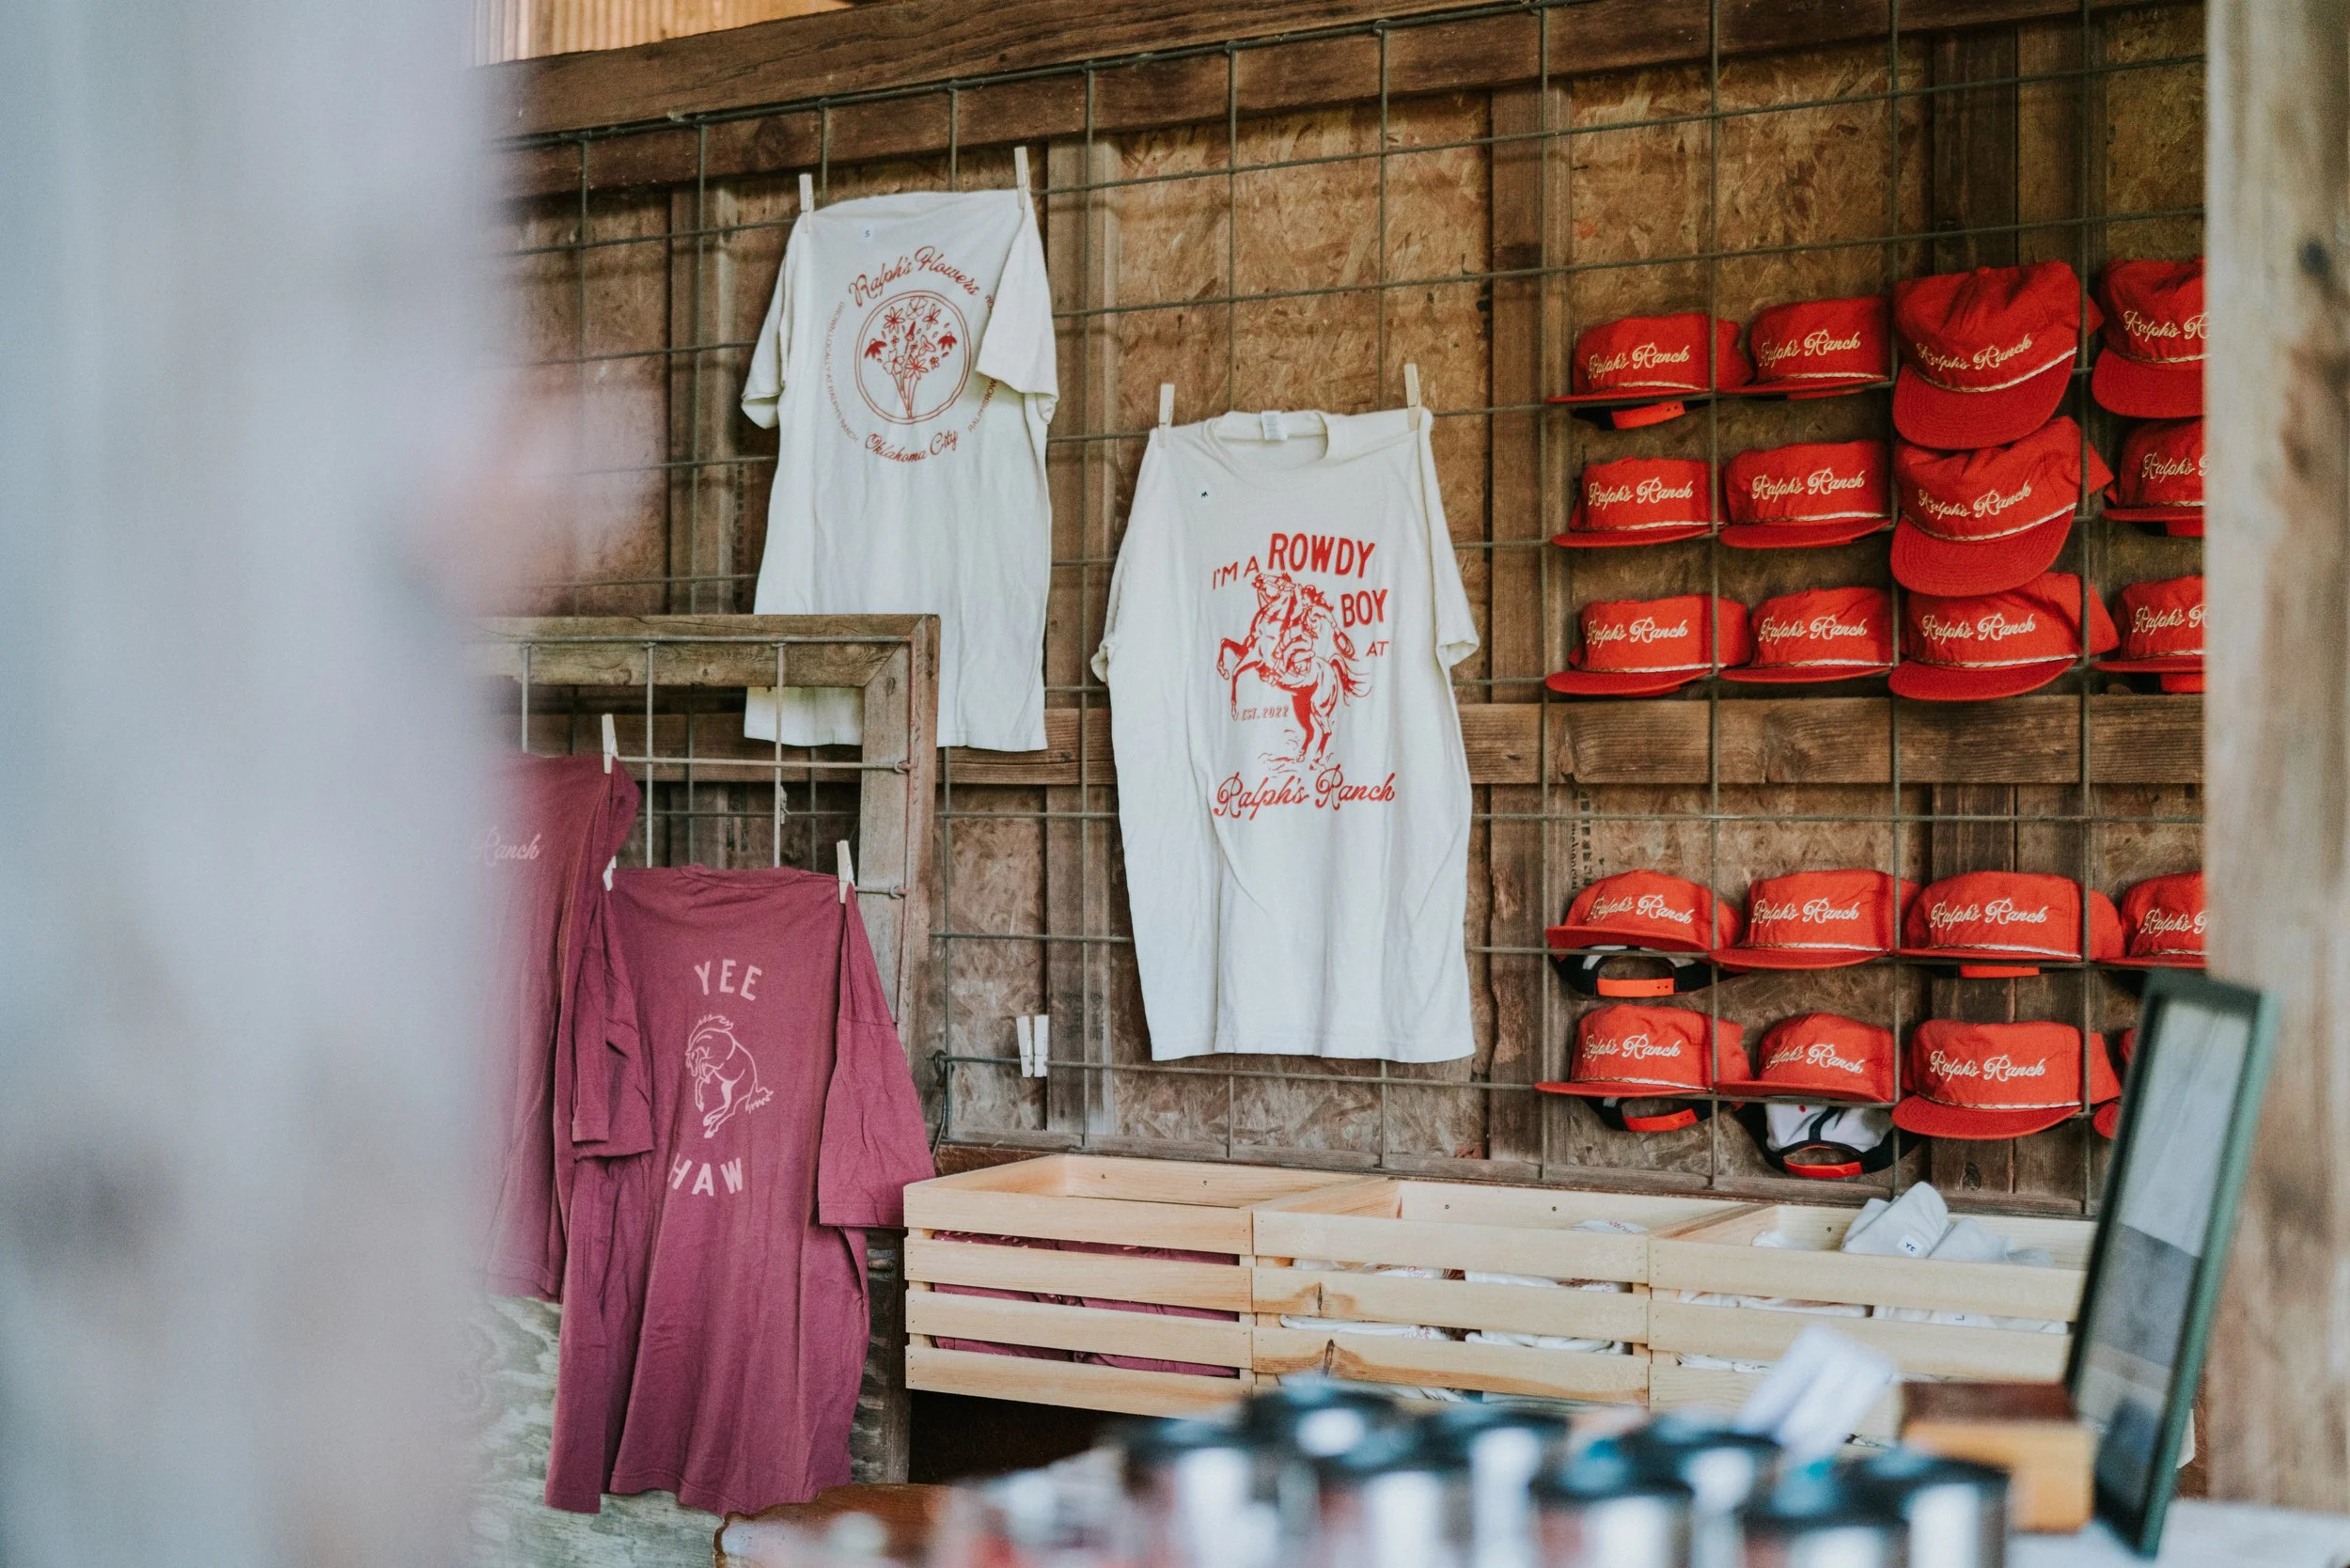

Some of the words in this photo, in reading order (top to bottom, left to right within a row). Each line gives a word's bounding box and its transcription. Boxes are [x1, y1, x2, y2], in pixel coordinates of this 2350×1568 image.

[849, 256, 913, 307] Ralph's
[915, 245, 979, 295] Flowers
[2123, 311, 2181, 342] Ralph's
[1589, 353, 1629, 381] Ralph's
[1632, 341, 1690, 369] Ranch
[1760, 340, 1800, 368] Ralph's
[1804, 329, 1860, 356] Ranch
[1917, 343, 1970, 371] Ralph's
[1973, 333, 2031, 370] Ranch
[865, 433, 928, 463] Oklahoma
[930, 430, 958, 456] City
[2142, 453, 2195, 483] Ralph's
[1589, 481, 1634, 510] Ralph's
[1637, 477, 1693, 503] Ranch
[1752, 474, 1804, 503] Ralph's
[1808, 467, 1865, 494] Ranch
[1919, 489, 1970, 520] Ralph's
[1973, 480, 2031, 518] Ranch
[1213, 561, 1238, 590] I'M
[1243, 556, 1260, 578] A
[1267, 532, 1375, 579] ROWDY
[1340, 588, 1388, 628] BOY
[2132, 605, 2186, 635] Ralph's
[1587, 619, 1627, 649] Ralph's
[1629, 617, 1688, 643] Ranch
[1758, 617, 1807, 645] Ralph's
[1810, 615, 1867, 640] Ranch
[1921, 615, 1974, 645] Ralph's
[1977, 613, 2036, 641] Ranch
[1365, 641, 1389, 656] AT
[1262, 706, 1289, 718] 2022
[1213, 772, 1309, 821] Ralph's
[1316, 763, 1396, 811] Ranch
[1586, 896, 1635, 921] Ralph's
[1636, 894, 1695, 924] Ranch
[1751, 899, 1800, 927] Ralph's
[1802, 897, 1860, 924] Ranch
[1929, 901, 1982, 931] Ralph's
[1984, 898, 2048, 924] Ranch
[2139, 908, 2192, 937] Ralph's
[694, 959, 762, 1001] YEE
[1583, 1034, 1620, 1062] Ralph's
[1622, 1033, 1682, 1059] Ranch
[1806, 1043, 1865, 1074] Ranch
[1930, 1050, 1981, 1082] Ralph's
[1983, 1055, 2045, 1082] Ranch
[667, 1152, 743, 1197] HAW
